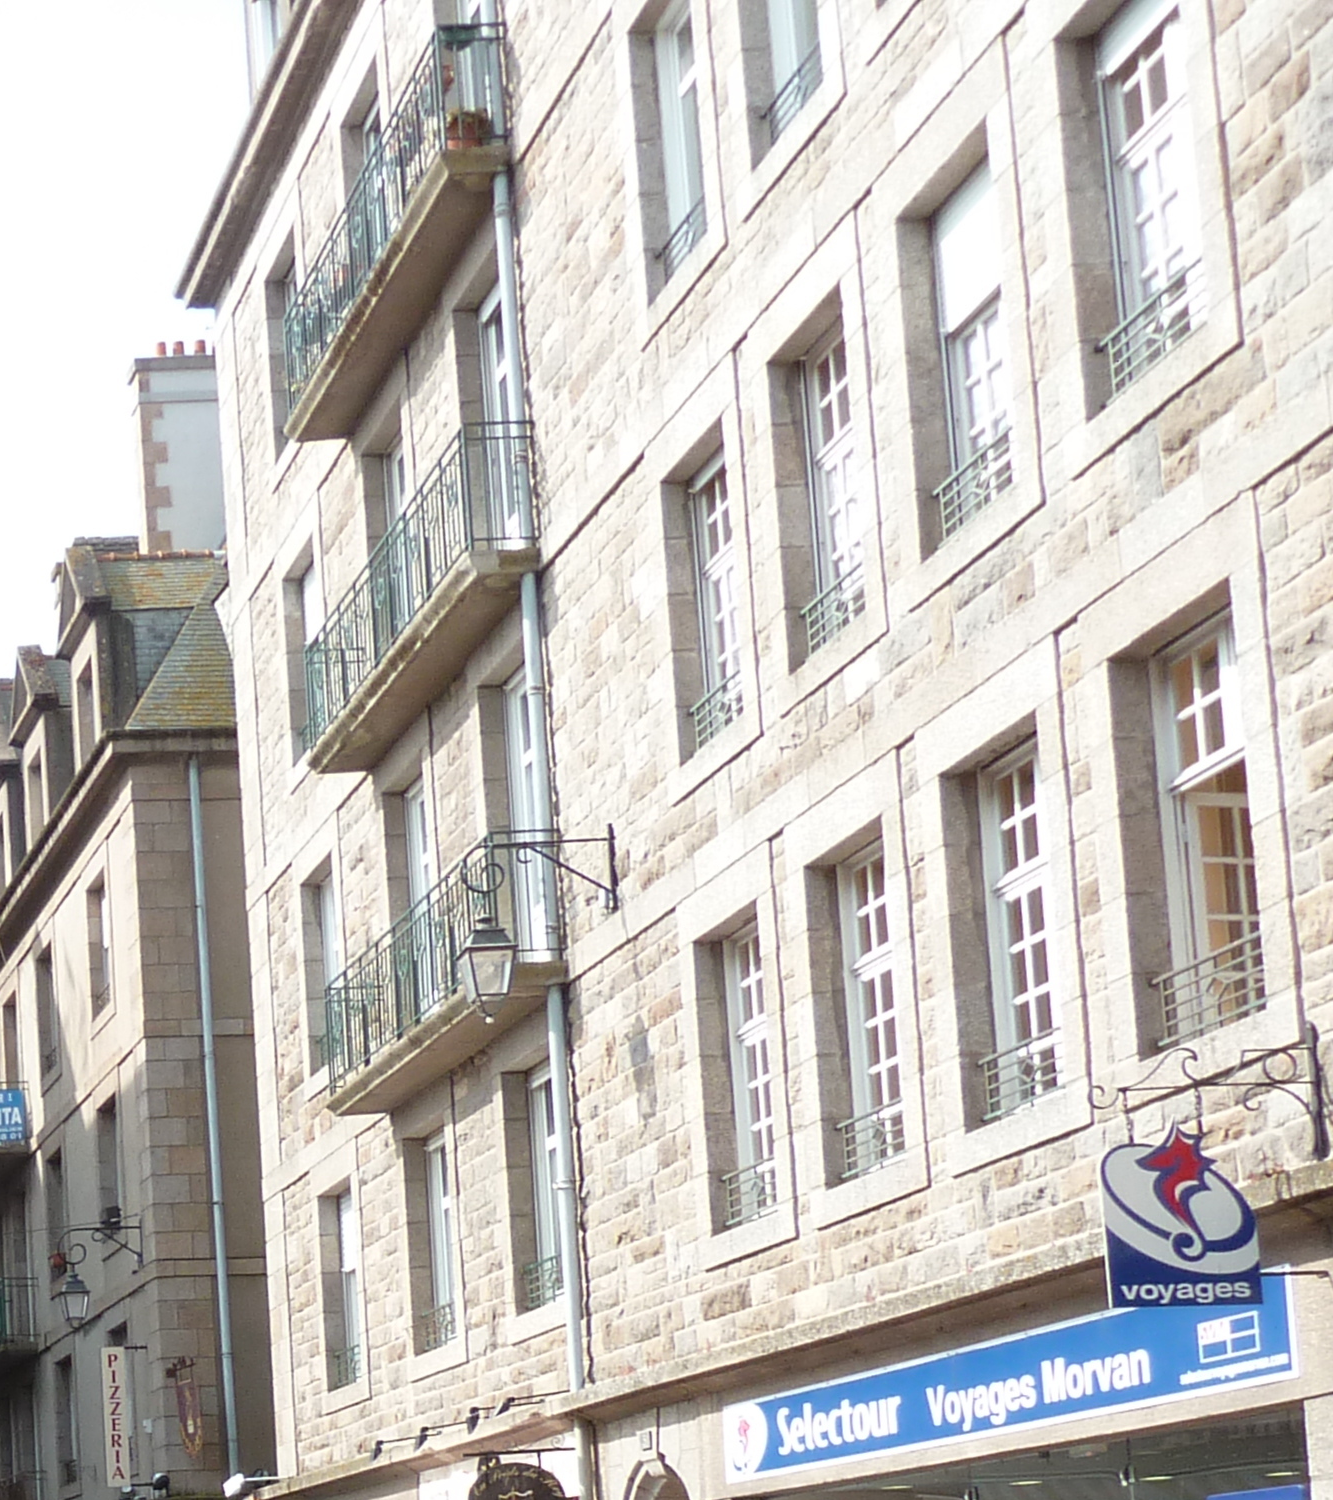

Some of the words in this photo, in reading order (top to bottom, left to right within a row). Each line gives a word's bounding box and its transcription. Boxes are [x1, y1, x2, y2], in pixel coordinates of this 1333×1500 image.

[1120, 1281, 1251, 1304] voyages
[107, 1353, 125, 1480] PIZZERIA
[776, 1395, 901, 1456] Selectour
[925, 1373, 1036, 1431] Voyages
[1040, 1348, 1151, 1404] Morvan
